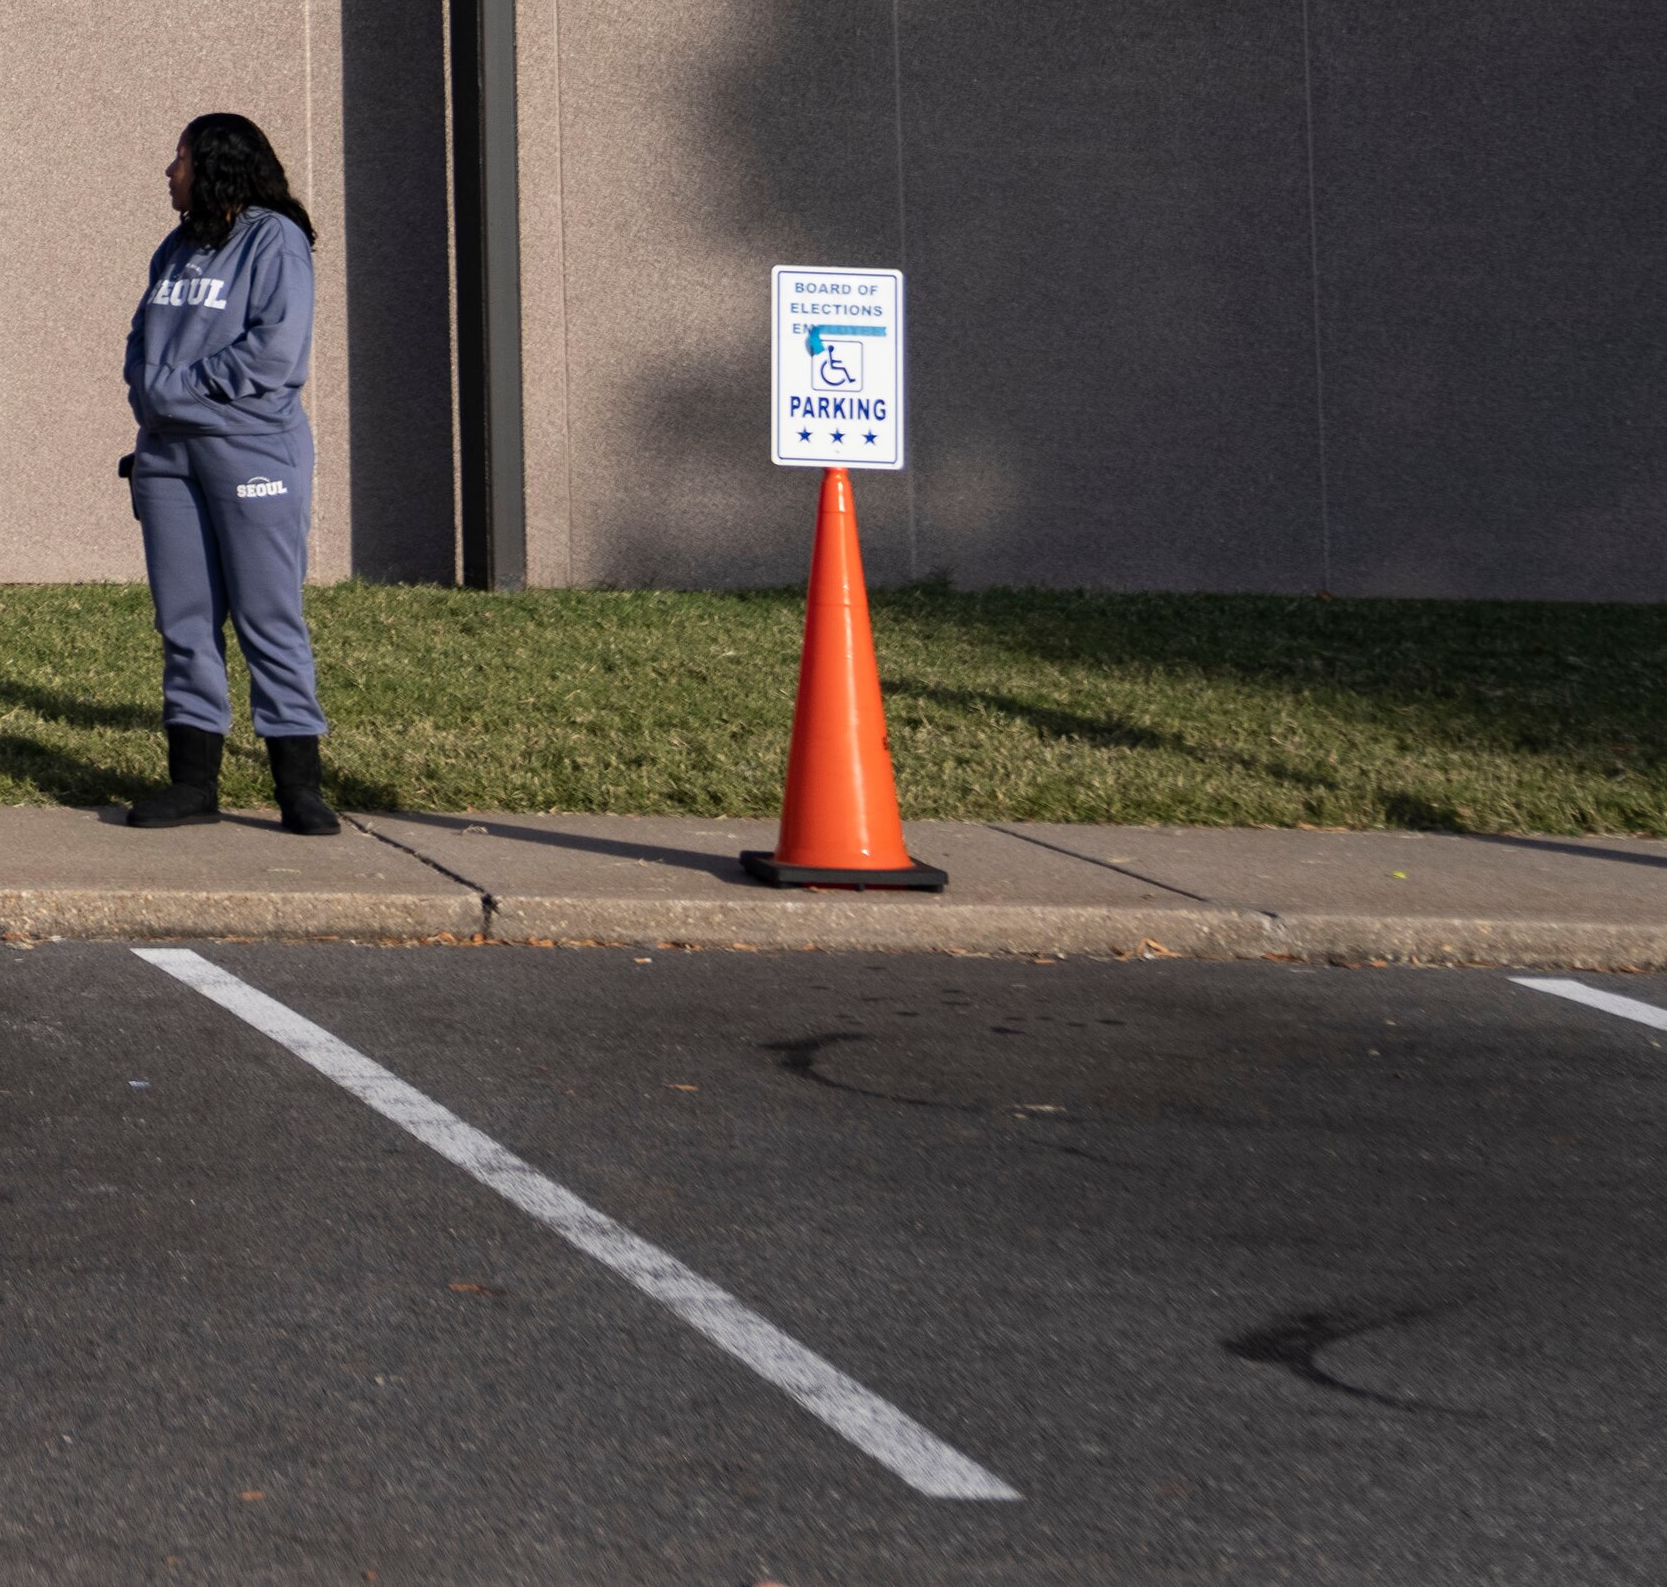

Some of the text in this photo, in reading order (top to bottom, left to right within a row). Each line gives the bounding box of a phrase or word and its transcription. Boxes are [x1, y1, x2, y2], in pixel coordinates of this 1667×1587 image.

[795, 282, 878, 296] BOARD OF
[790, 303, 883, 317] ELECTIONS
[790, 396, 887, 421] PARKING
[236, 479, 288, 498] SEOUL
